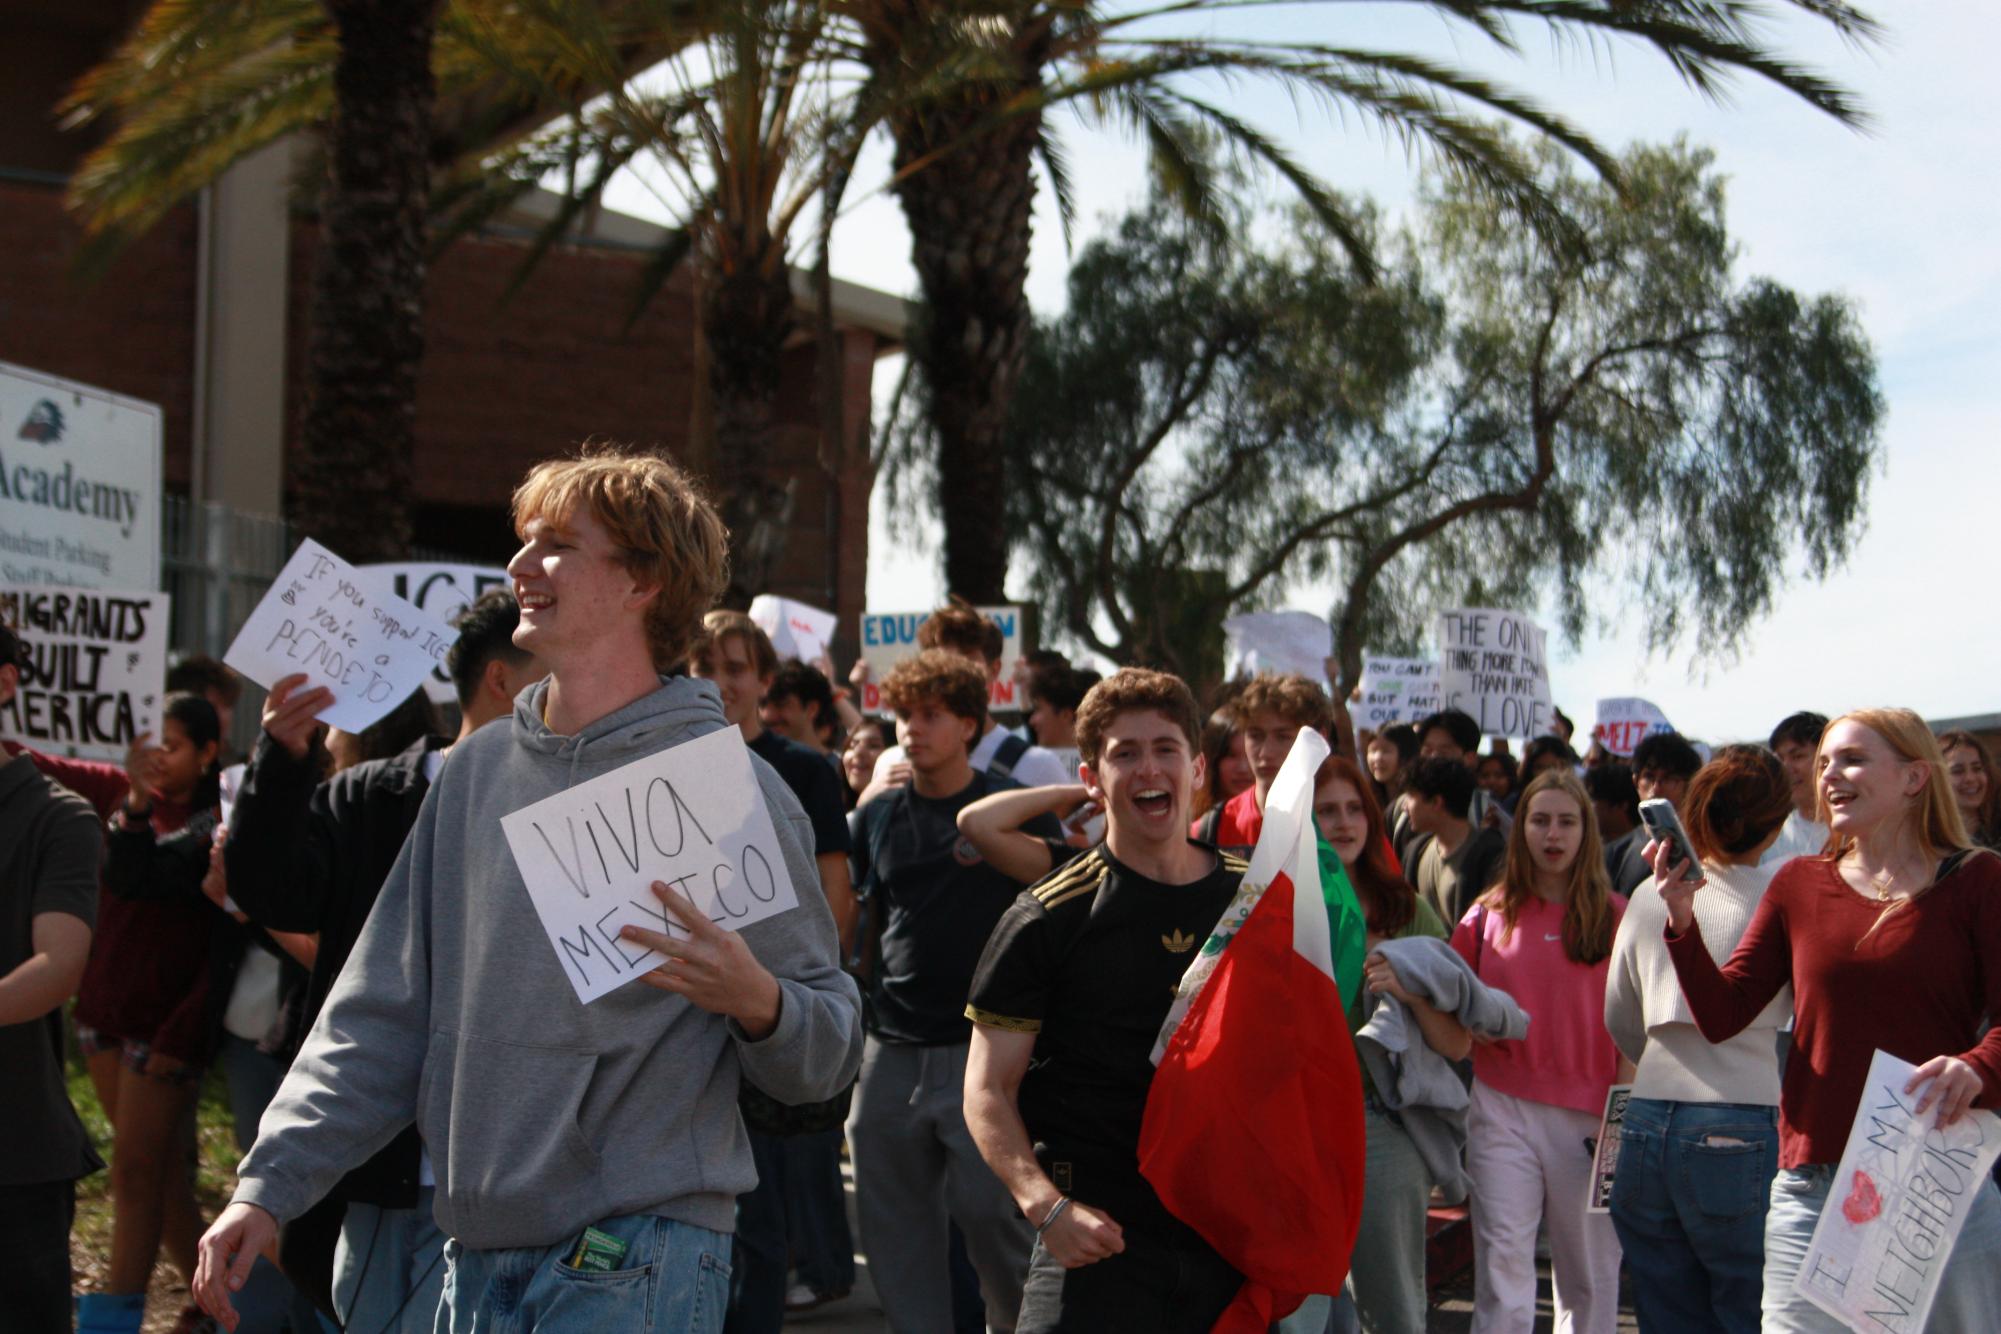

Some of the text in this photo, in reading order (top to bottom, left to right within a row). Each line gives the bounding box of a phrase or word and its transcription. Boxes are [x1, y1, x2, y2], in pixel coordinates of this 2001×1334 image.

[327, 579, 364, 608] you
[1442, 612, 1489, 647] THE
[16, 638, 109, 692] BUILT
[1445, 649, 1477, 673] THING
[1482, 653, 1517, 674] MORE
[1471, 673, 1507, 694] THAN
[1480, 697, 1546, 737] LOVE
[558, 844, 776, 987] MEXICO
[1866, 1085, 1914, 1155] MY
